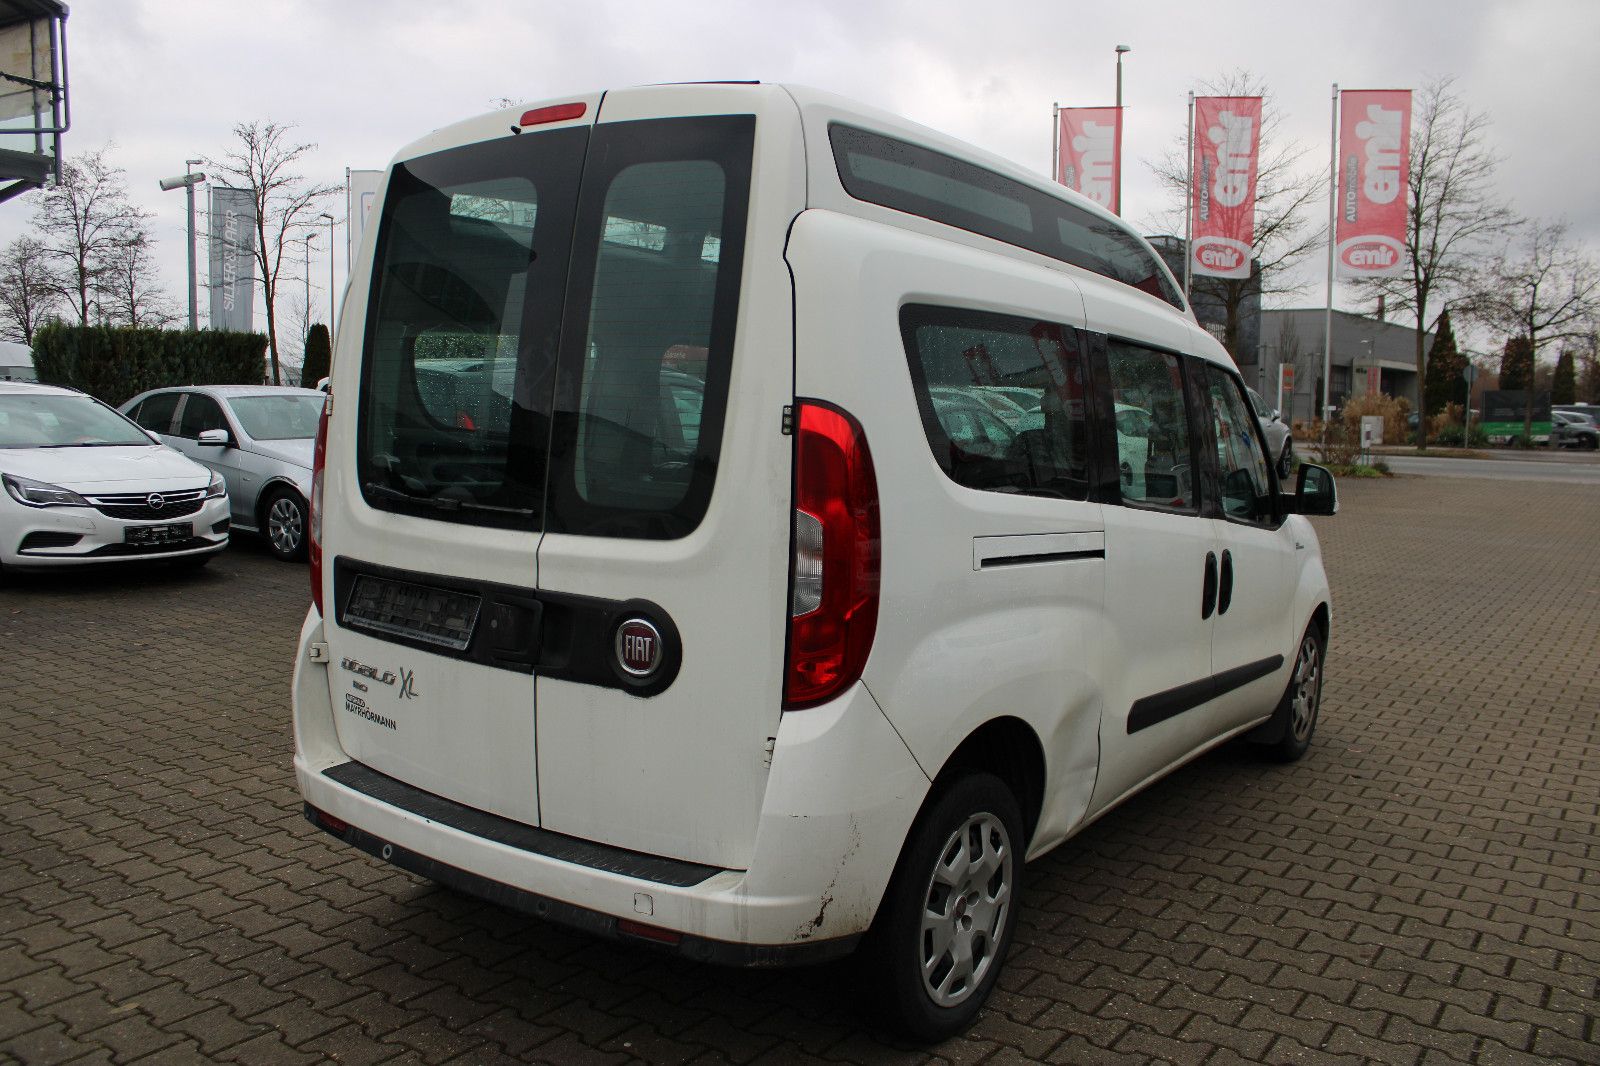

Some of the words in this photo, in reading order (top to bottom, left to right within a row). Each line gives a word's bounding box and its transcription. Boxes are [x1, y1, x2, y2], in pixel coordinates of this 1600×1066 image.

[1207, 110, 1252, 208] emir
[1355, 104, 1402, 204] emir
[1202, 248, 1239, 268] emir
[1350, 245, 1393, 265] emir
[625, 635, 652, 661] FIAT
[399, 666, 419, 699] XL
